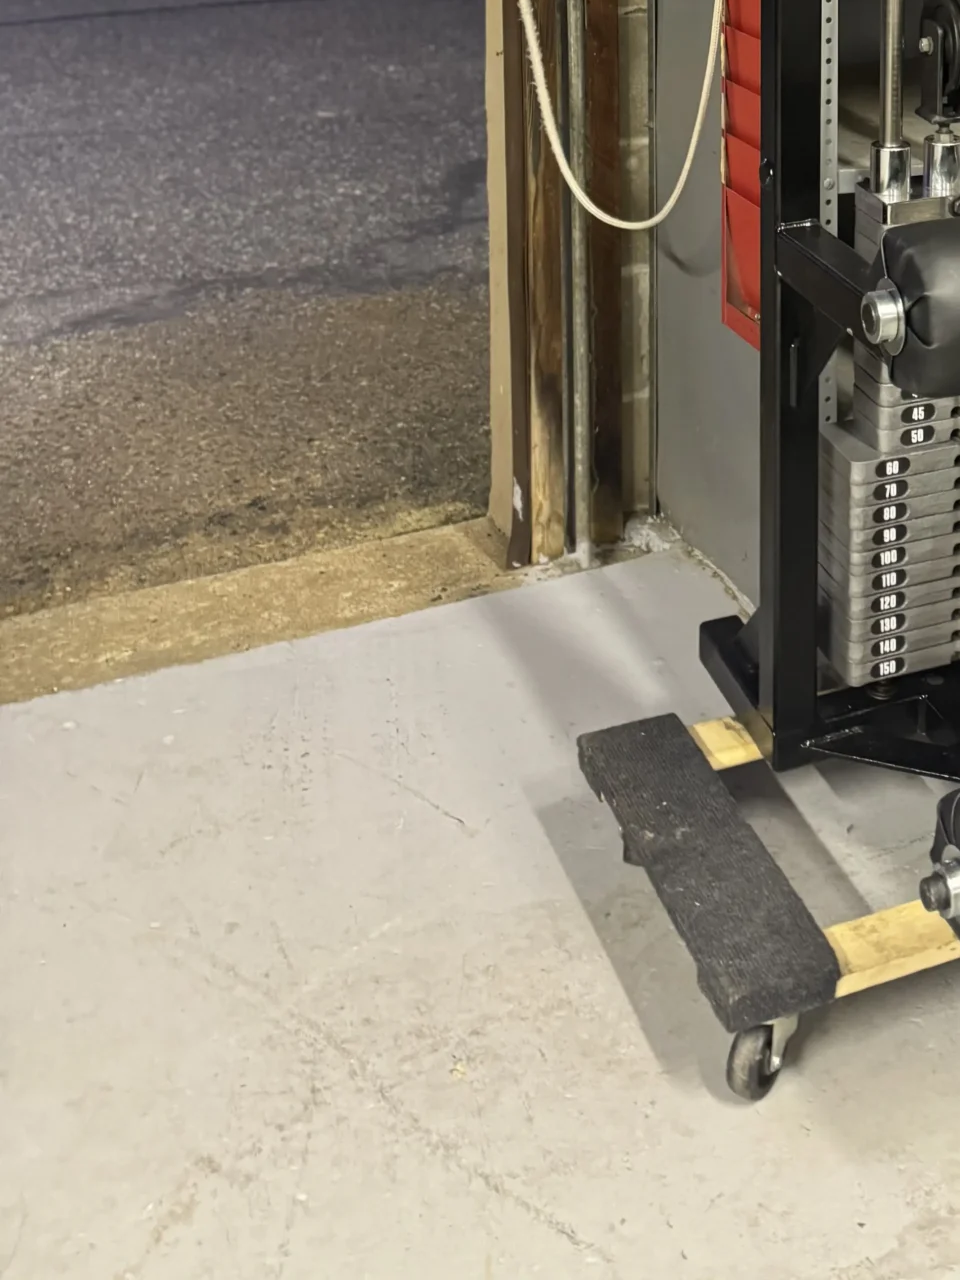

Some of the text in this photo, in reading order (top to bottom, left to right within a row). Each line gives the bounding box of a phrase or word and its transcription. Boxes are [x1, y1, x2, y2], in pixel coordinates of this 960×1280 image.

[912, 408, 925, 420] 45
[911, 430, 923, 443] 50
[886, 461, 899, 474] 60
[885, 484, 897, 497] 70
[883, 506, 896, 520] 80
[883, 528, 896, 541] 90
[880, 550, 897, 564] 100
[881, 572, 897, 586] 110
[880, 595, 896, 609] 120
[879, 617, 897, 631] 130
[879, 639, 896, 653] 140
[879, 660, 896, 674] 150
